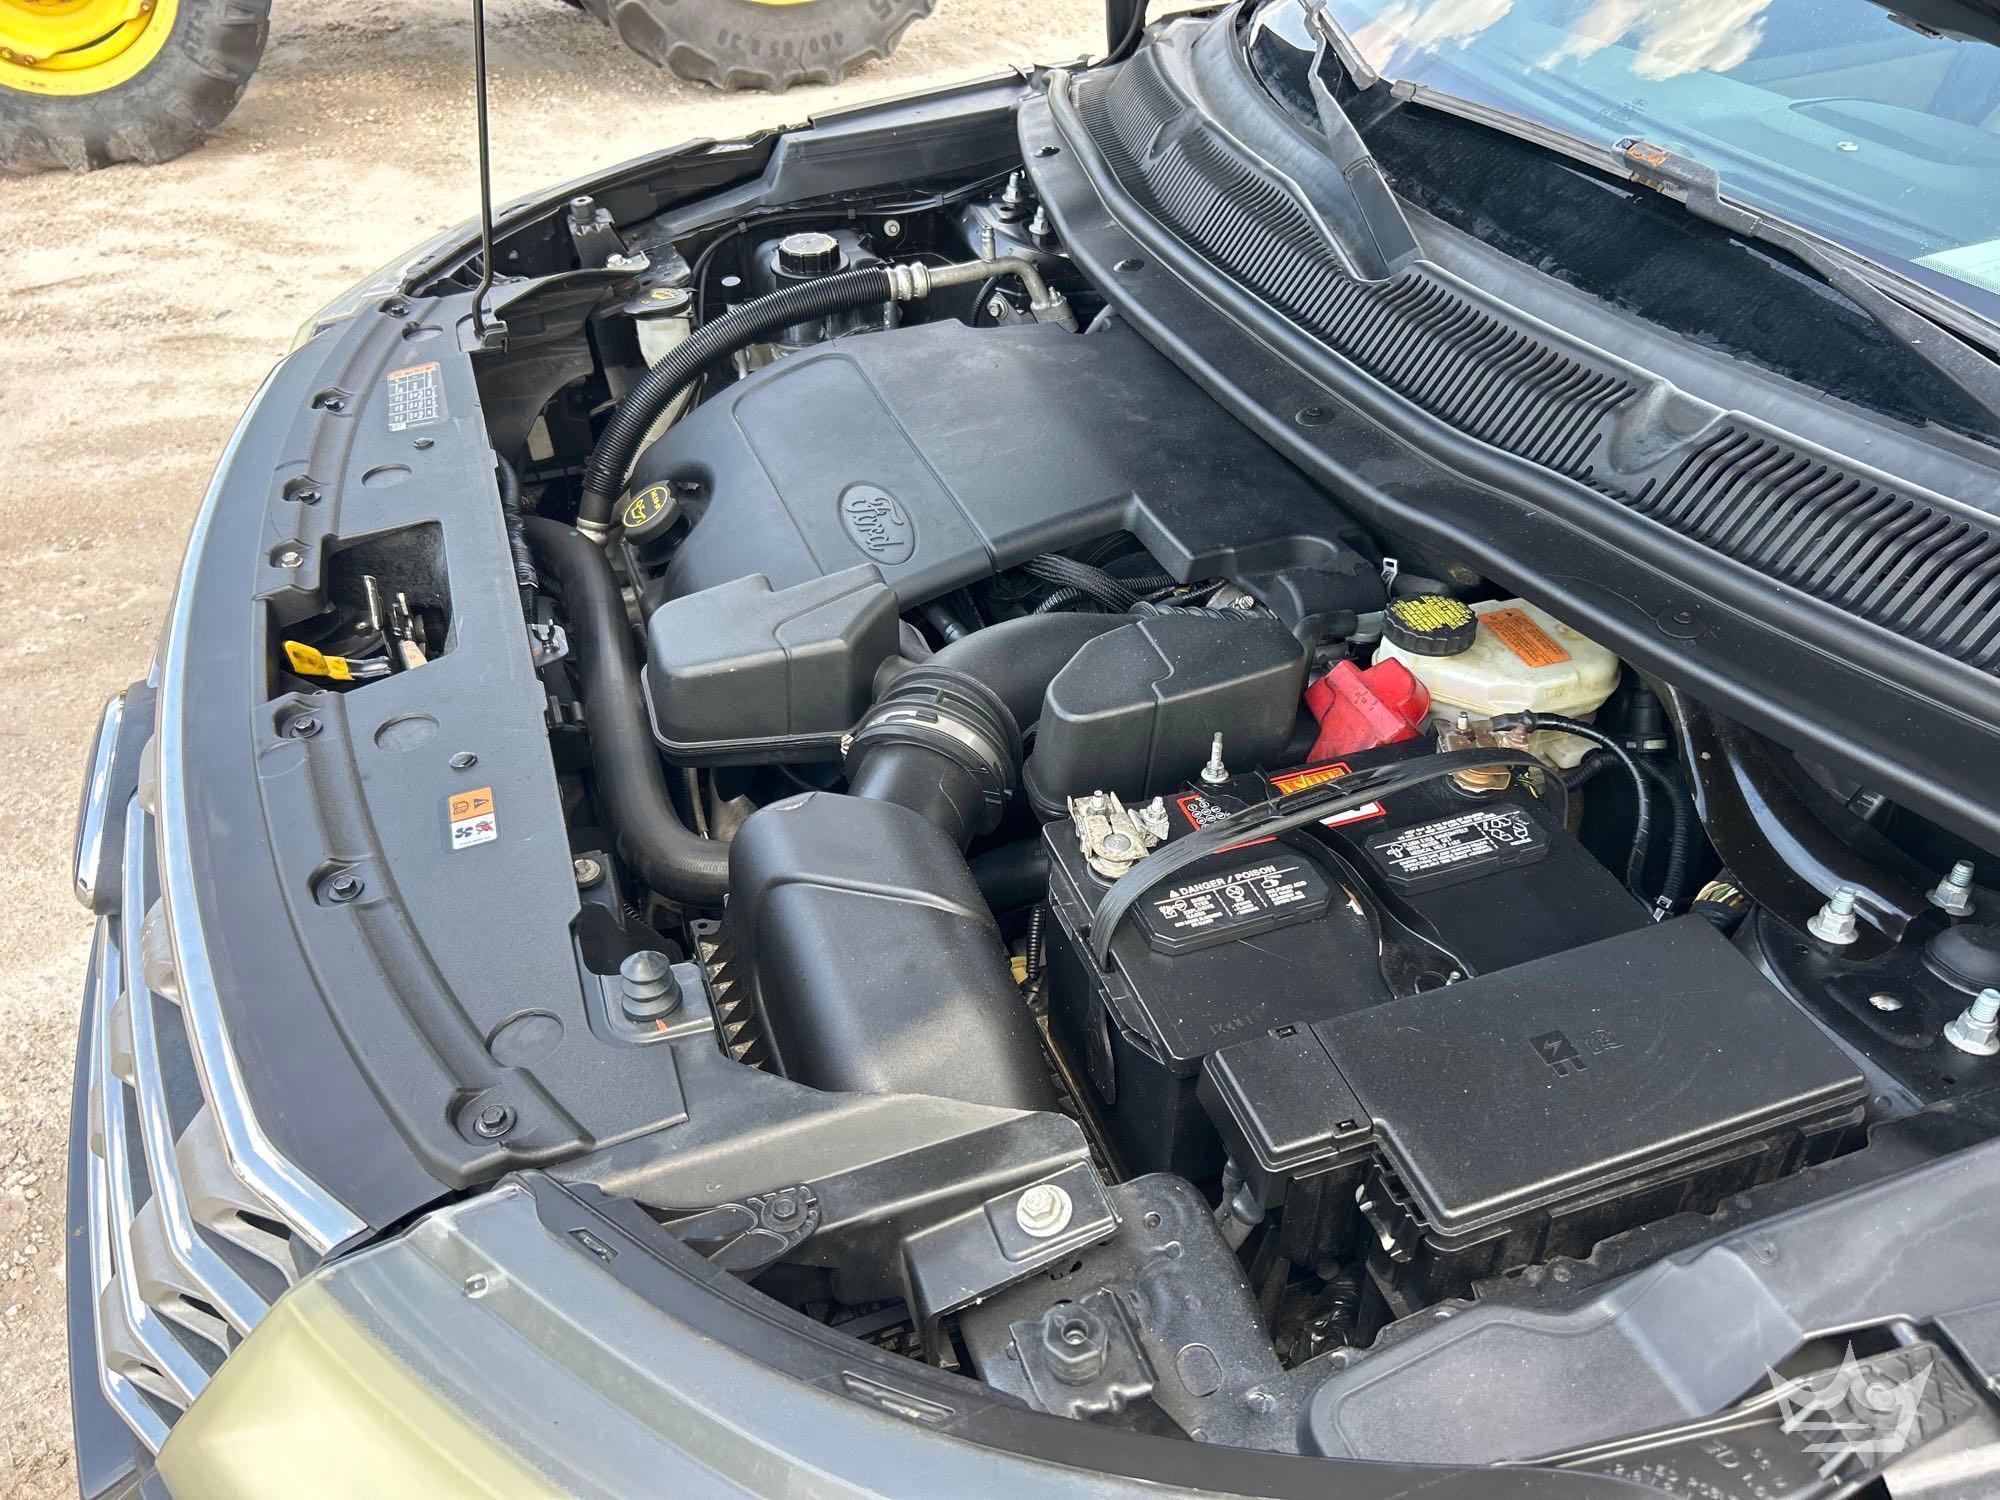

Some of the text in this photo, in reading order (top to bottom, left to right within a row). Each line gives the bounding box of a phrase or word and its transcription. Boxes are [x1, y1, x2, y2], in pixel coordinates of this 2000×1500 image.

[845, 496, 904, 552] Ford
[1179, 878, 1225, 895] DANGER
[1235, 865, 1276, 881] POISON
